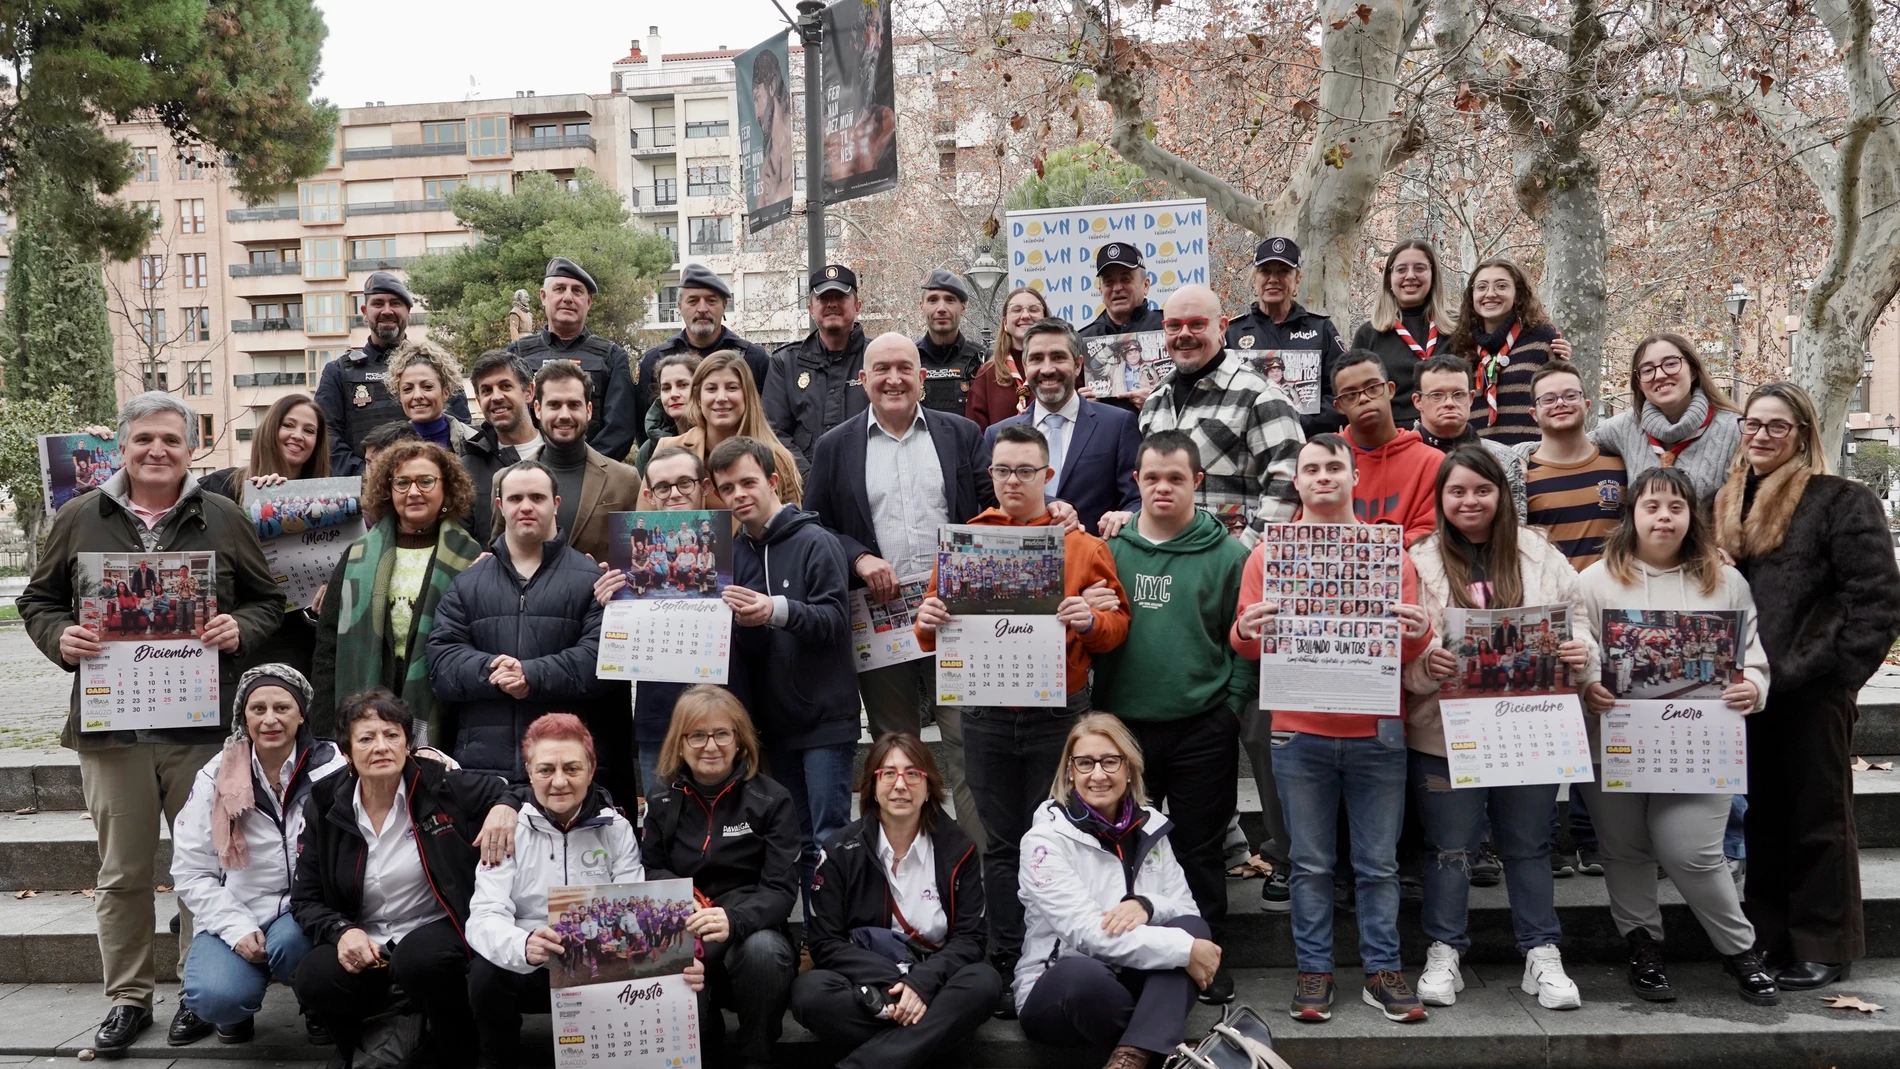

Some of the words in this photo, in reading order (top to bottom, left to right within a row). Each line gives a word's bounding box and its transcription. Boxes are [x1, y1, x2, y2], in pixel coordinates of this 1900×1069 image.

[828, 85, 840, 102] FER
[828, 101, 839, 118] NAN
[840, 112, 853, 130] MON
[741, 125, 750, 141] FER
[752, 150, 763, 167] MON
[753, 168, 760, 181] TA
[1013, 218, 1070, 238] DOWN
[1078, 214, 1136, 234] DOWN
[1144, 209, 1202, 230] DOWN
[1014, 247, 1071, 266] DOWN
[1146, 238, 1203, 259] DOWN
[1598, 486, 1619, 501] 46
[301, 529, 341, 546] Marzo
[1134, 574, 1172, 602] NYC
[650, 600, 718, 614] Septiembre
[995, 618, 1034, 638] Junio
[134, 645, 203, 662] Diciembre
[1296, 638, 1330, 654] BRILLANDO
[1335, 640, 1366, 654] JUNTOS
[187, 710, 215, 720] DOWN
[1495, 700, 1564, 717] Diciembre
[1662, 704, 1703, 721] Enero
[617, 982, 664, 1005] Agosto
